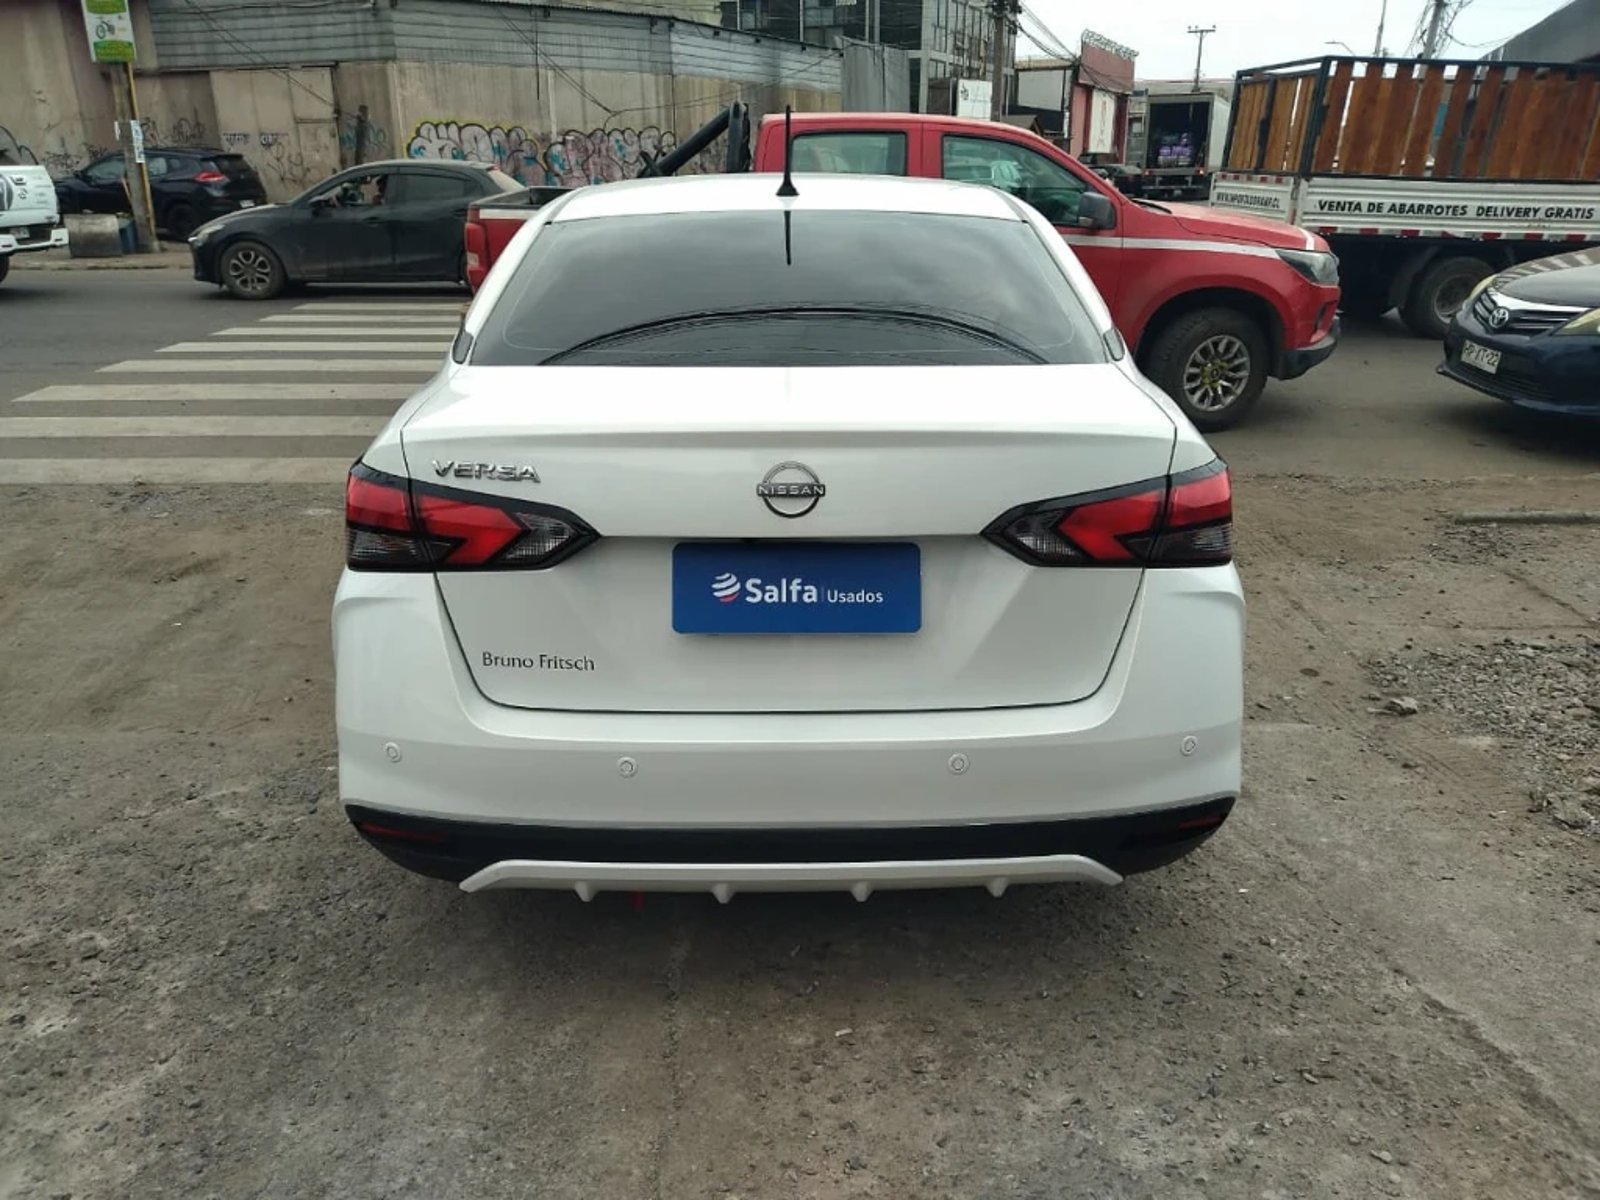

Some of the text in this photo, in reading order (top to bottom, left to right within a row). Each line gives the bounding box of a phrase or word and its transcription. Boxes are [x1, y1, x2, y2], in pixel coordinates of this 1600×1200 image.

[1318, 200, 1595, 220] VENTA DE ABARROTES DELIVERY GRATIS
[432, 460, 541, 483] VERSA
[758, 485, 824, 496] NISSAN
[745, 578, 884, 603] Salfa Usados
[482, 651, 595, 671] Bruno Fritsch
